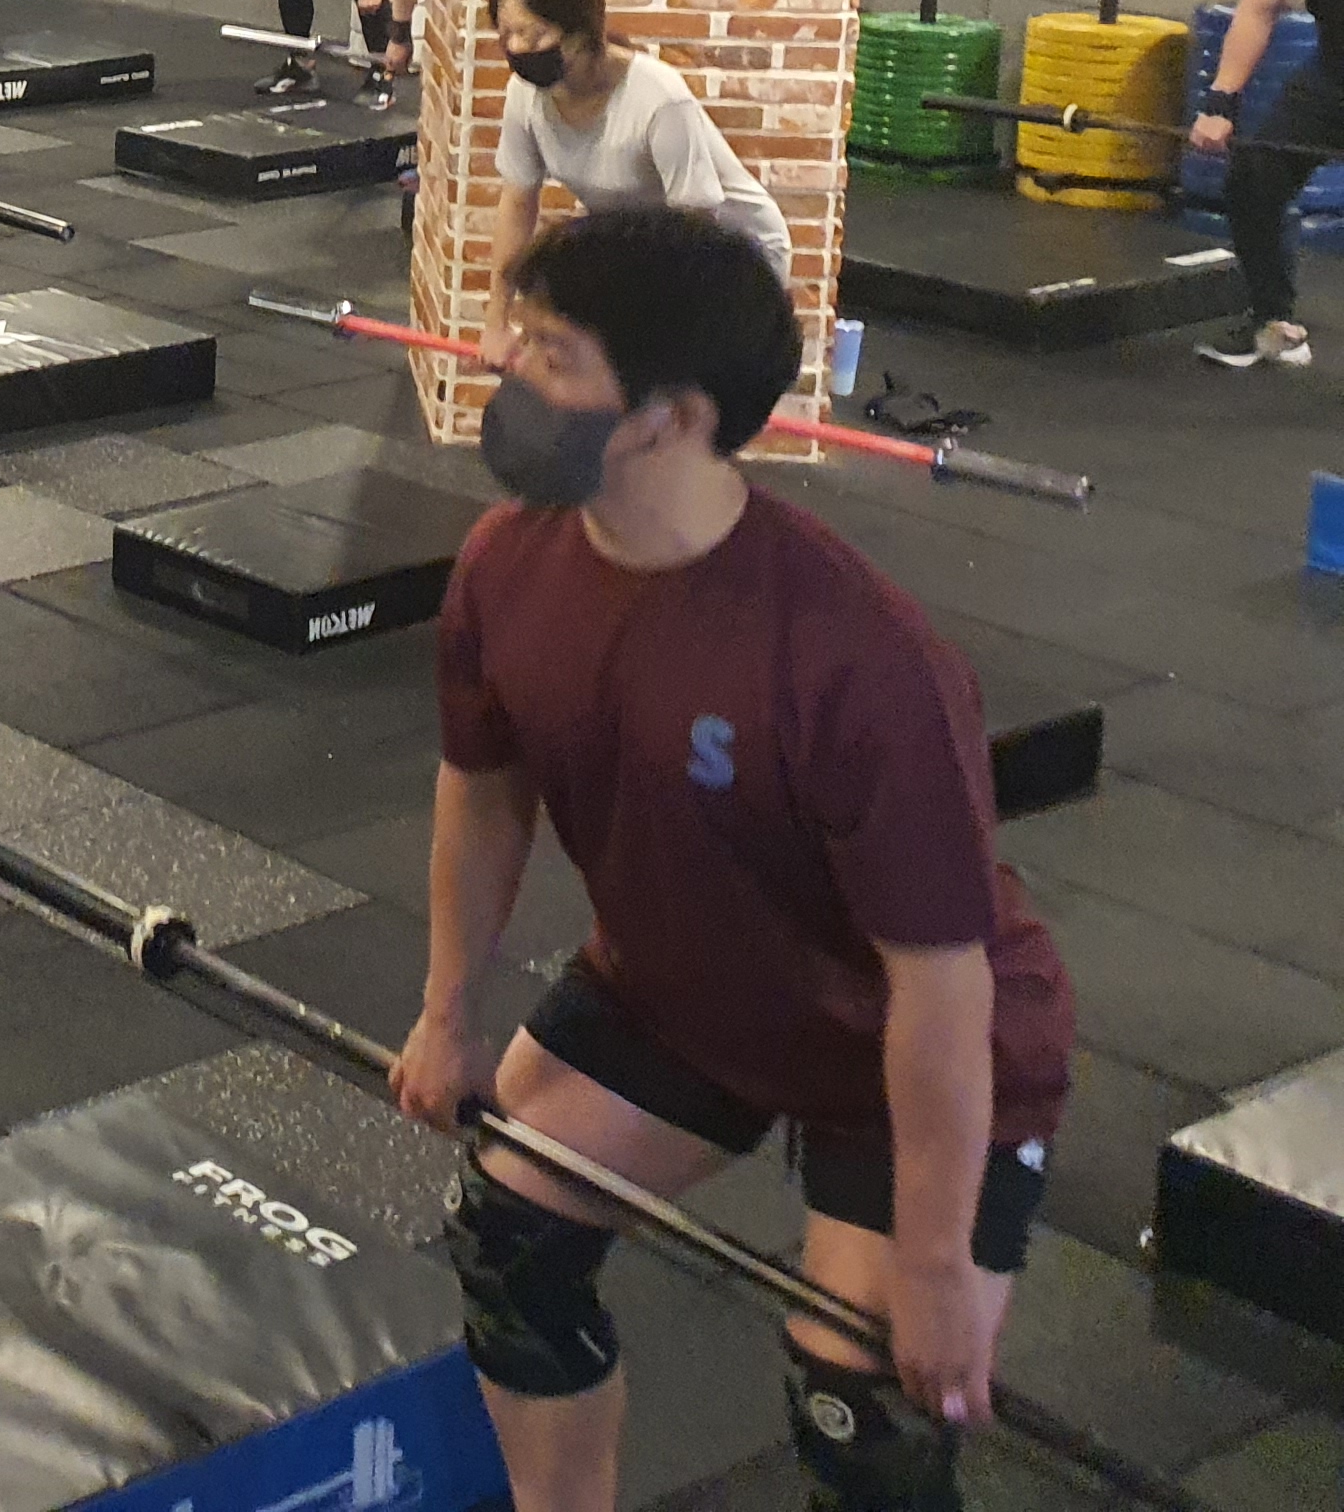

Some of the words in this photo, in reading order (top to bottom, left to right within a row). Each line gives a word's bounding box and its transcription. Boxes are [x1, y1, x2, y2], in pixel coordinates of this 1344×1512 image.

[309, 600, 375, 642] METCON
[687, 714, 735, 788] S
[189, 1160, 358, 1261] FROG
